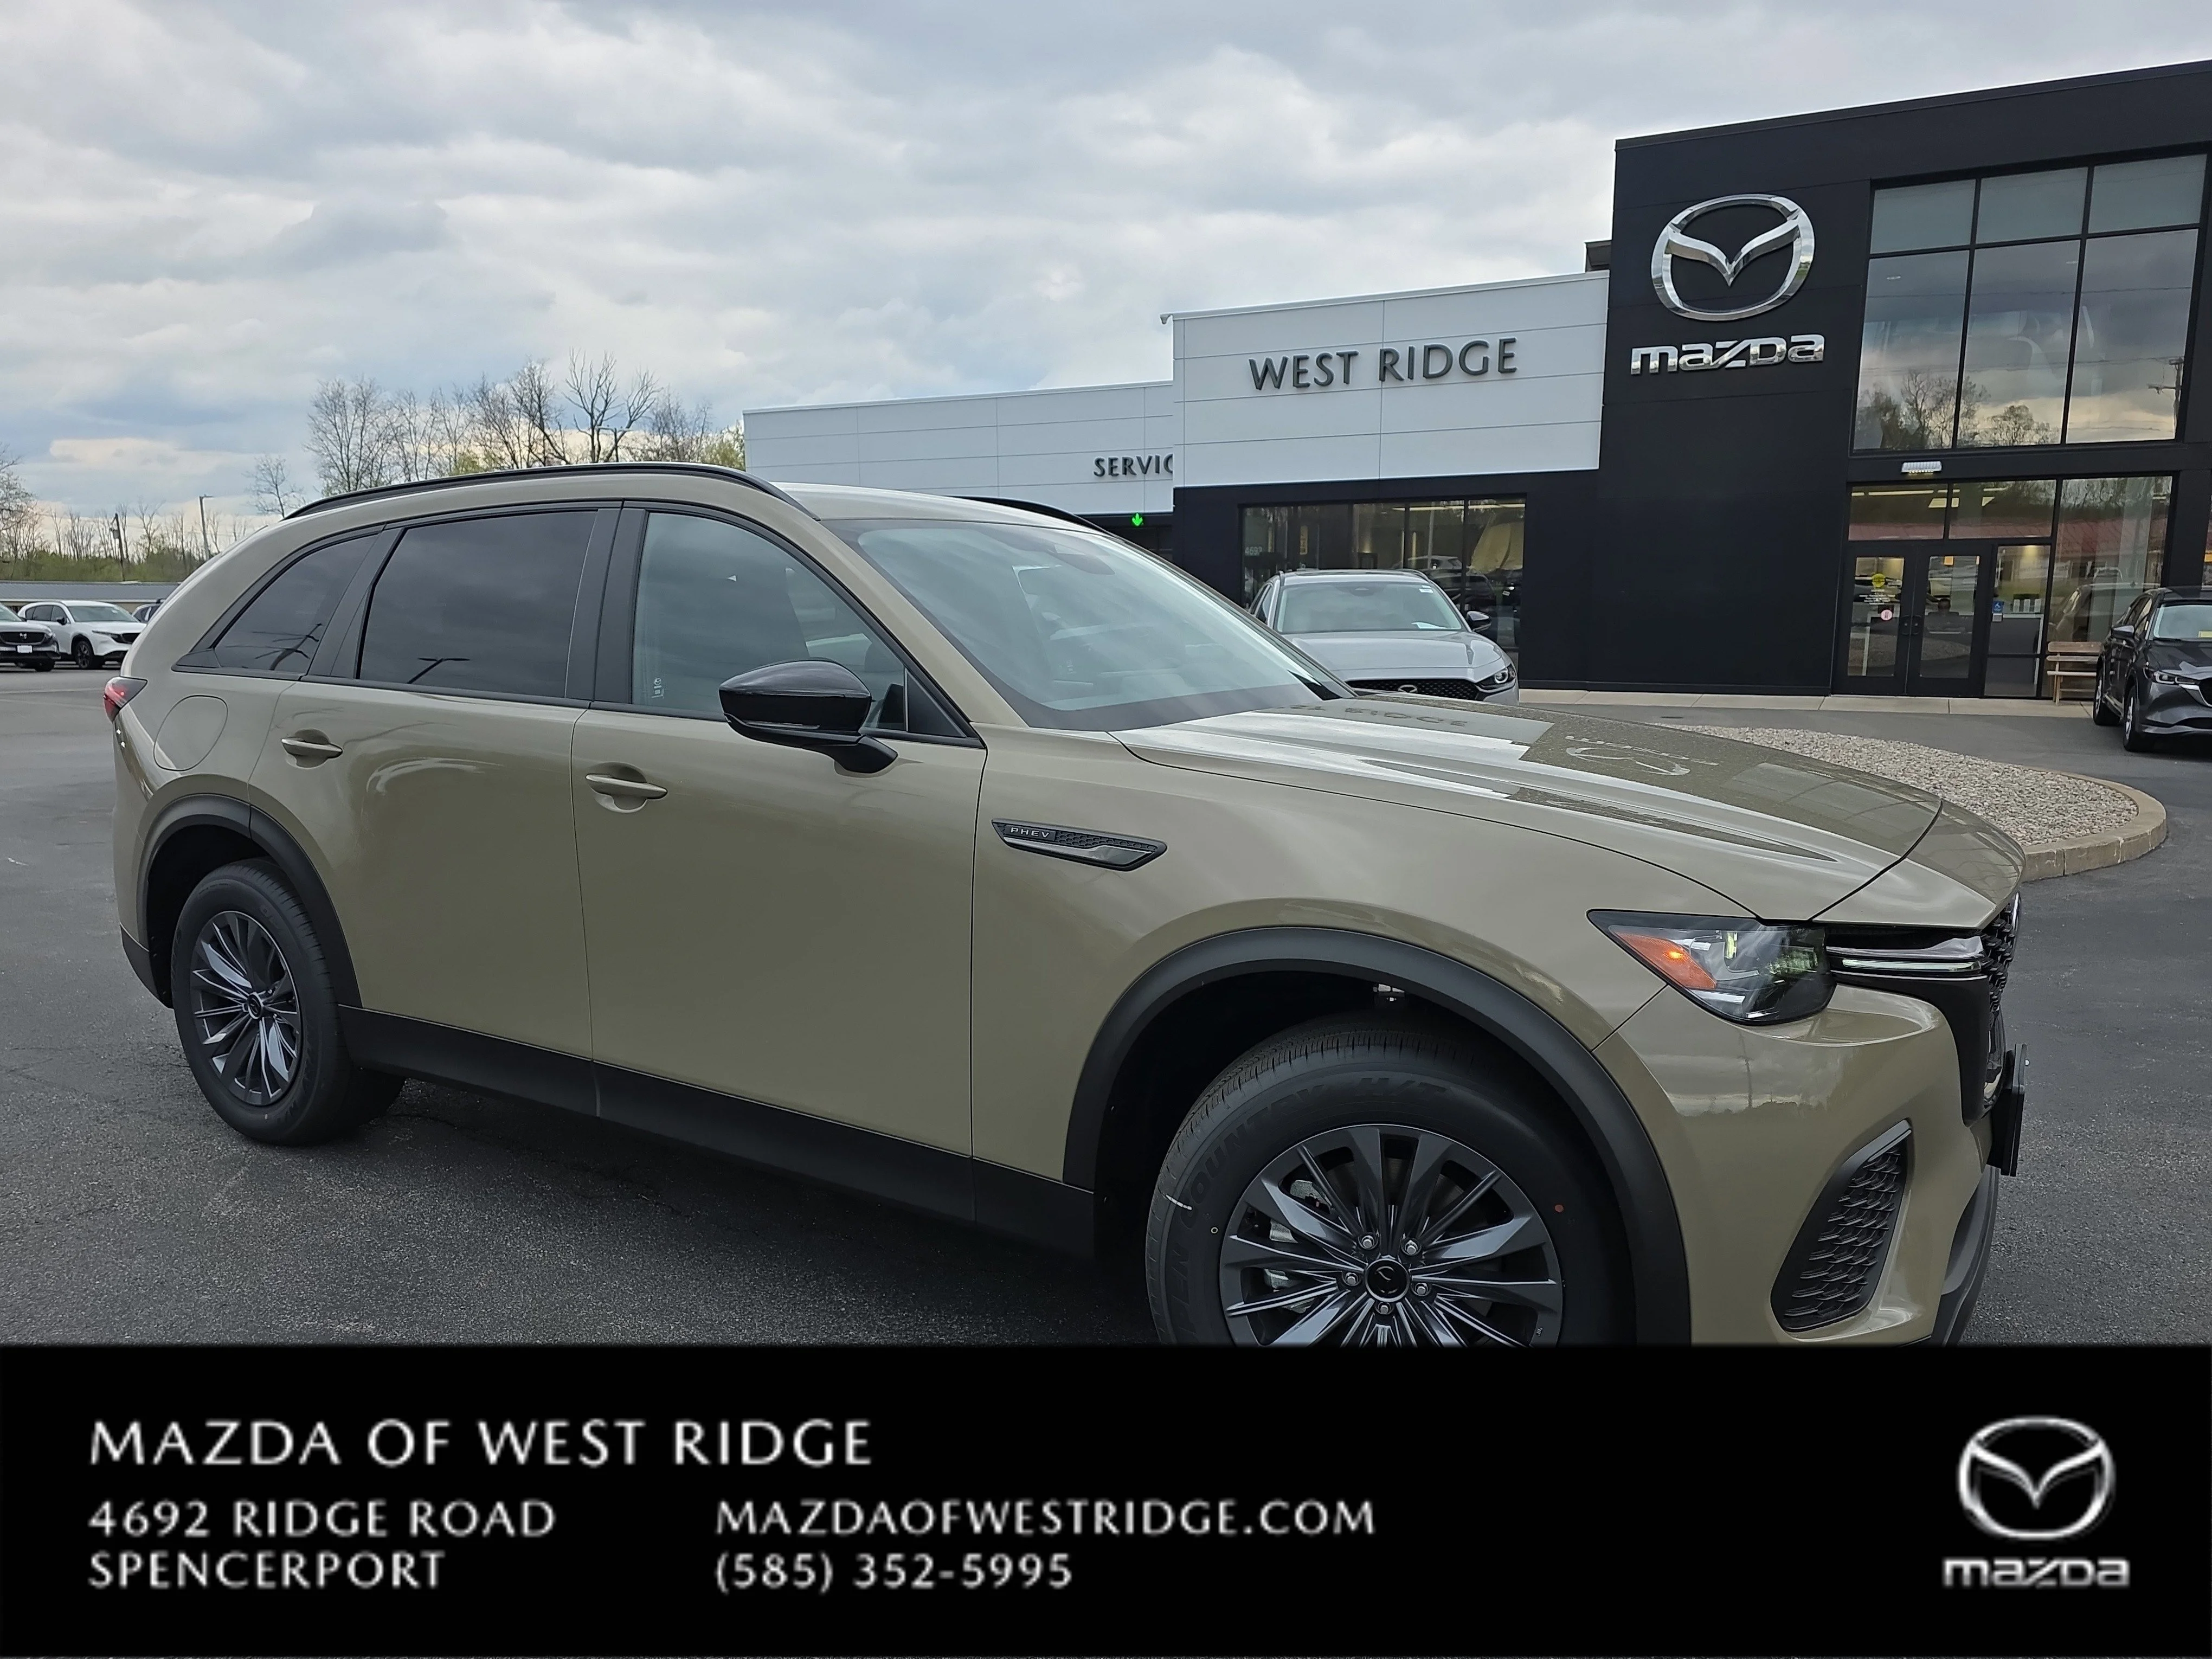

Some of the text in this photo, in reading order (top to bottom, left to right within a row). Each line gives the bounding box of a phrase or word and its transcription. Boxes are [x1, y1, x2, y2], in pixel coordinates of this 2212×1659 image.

[1249, 337, 1517, 391] WEST RIDGE
[1011, 827, 1050, 838] PHEV
[1181, 1084, 1327, 1229] COUNTRY
[1170, 1240, 1200, 1343] PEN
